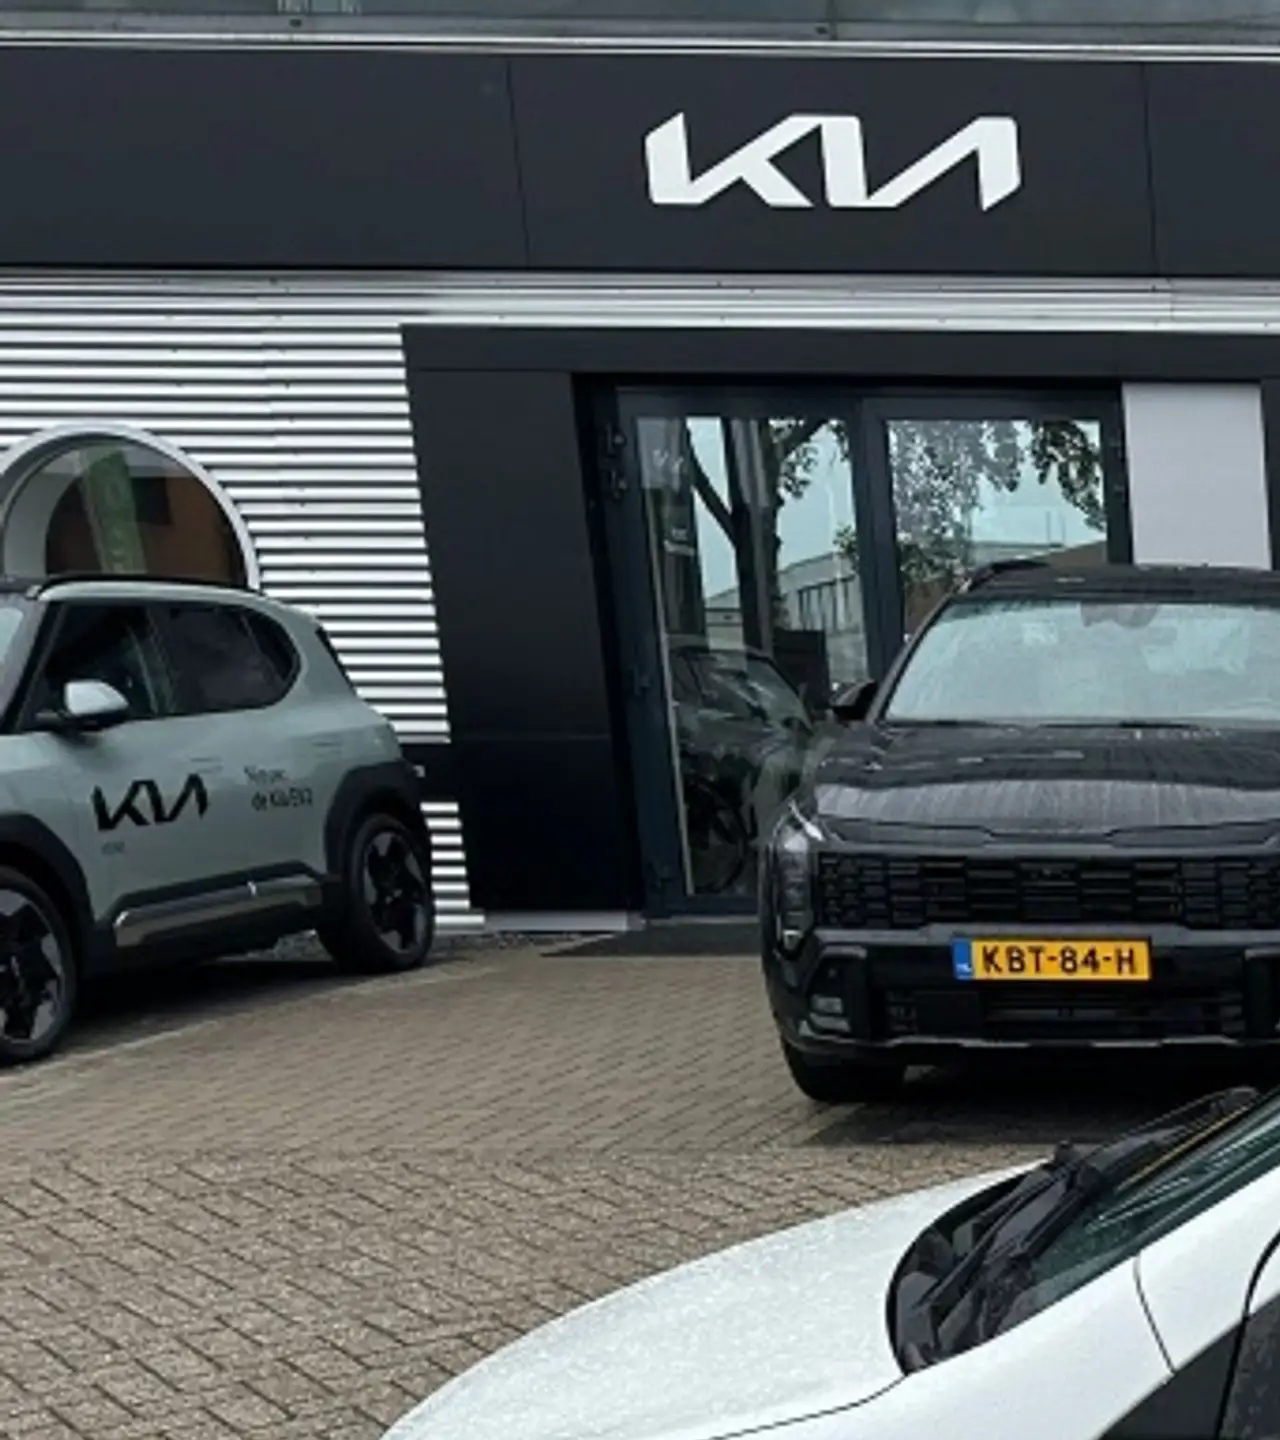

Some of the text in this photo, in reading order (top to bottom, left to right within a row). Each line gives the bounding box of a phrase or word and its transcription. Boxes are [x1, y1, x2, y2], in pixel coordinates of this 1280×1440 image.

[644, 111, 1022, 211] KIA
[91, 773, 208, 830] KIA
[982, 945, 1137, 975] KBT-84-H
